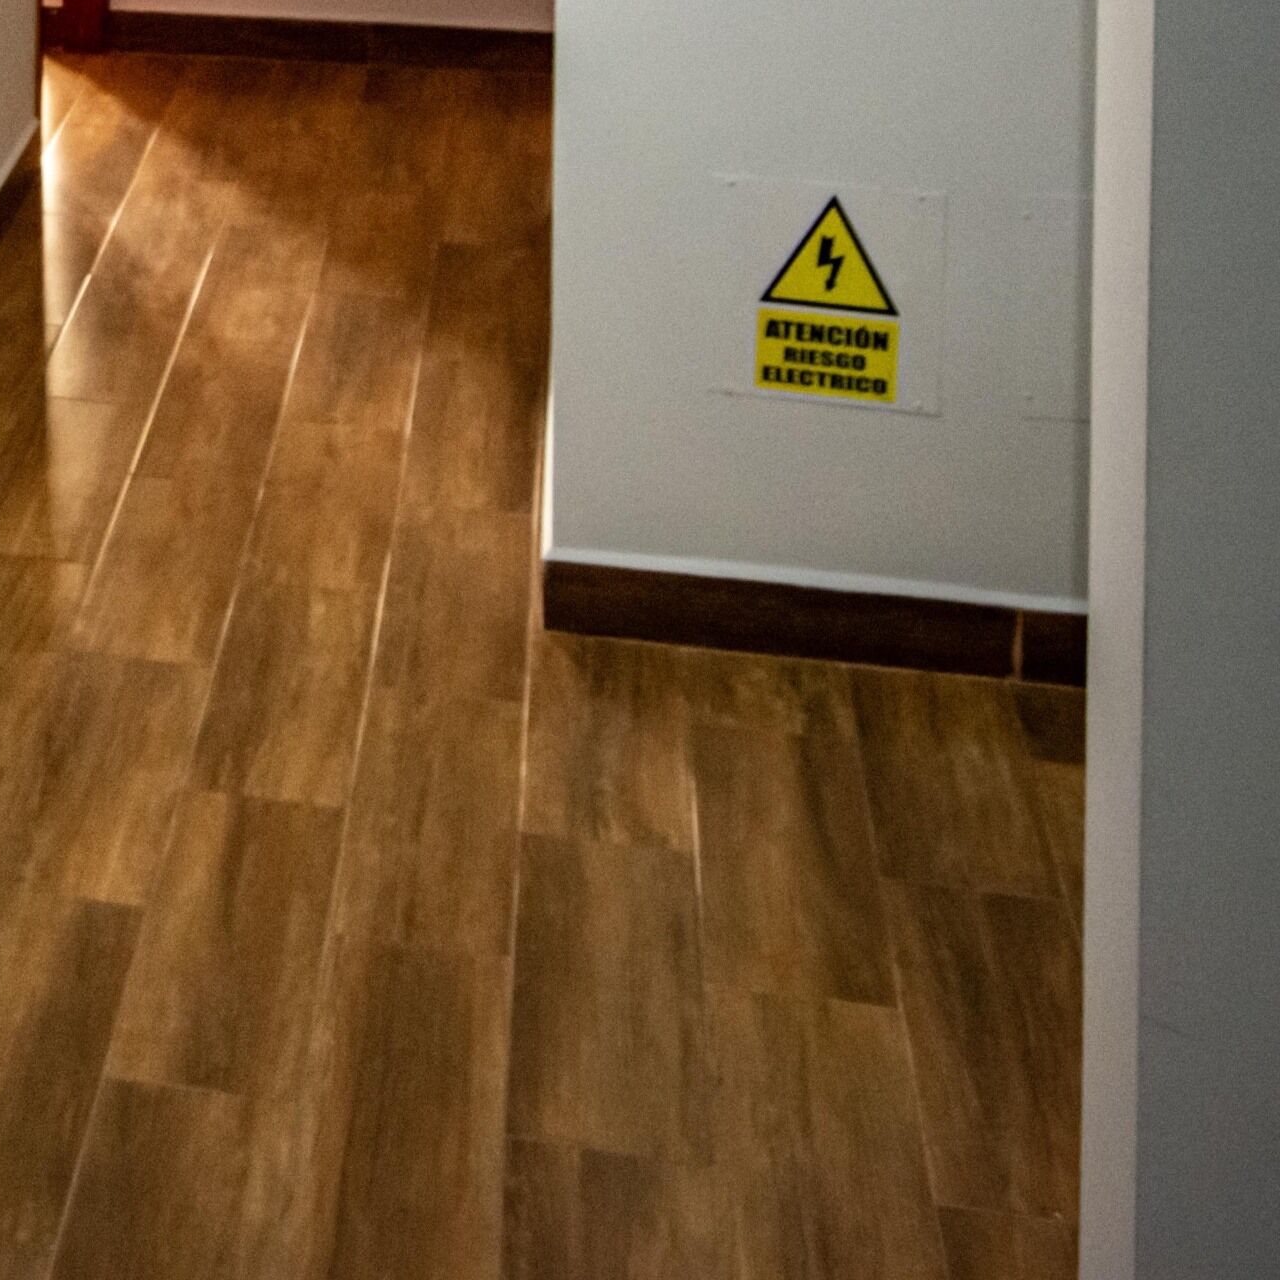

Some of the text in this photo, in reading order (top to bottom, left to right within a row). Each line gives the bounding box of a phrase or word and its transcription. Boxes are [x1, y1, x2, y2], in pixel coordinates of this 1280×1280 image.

[765, 319, 888, 351] ATENCIÓN
[784, 347, 866, 371] RIESGO
[762, 366, 886, 395] ELECTRICO
